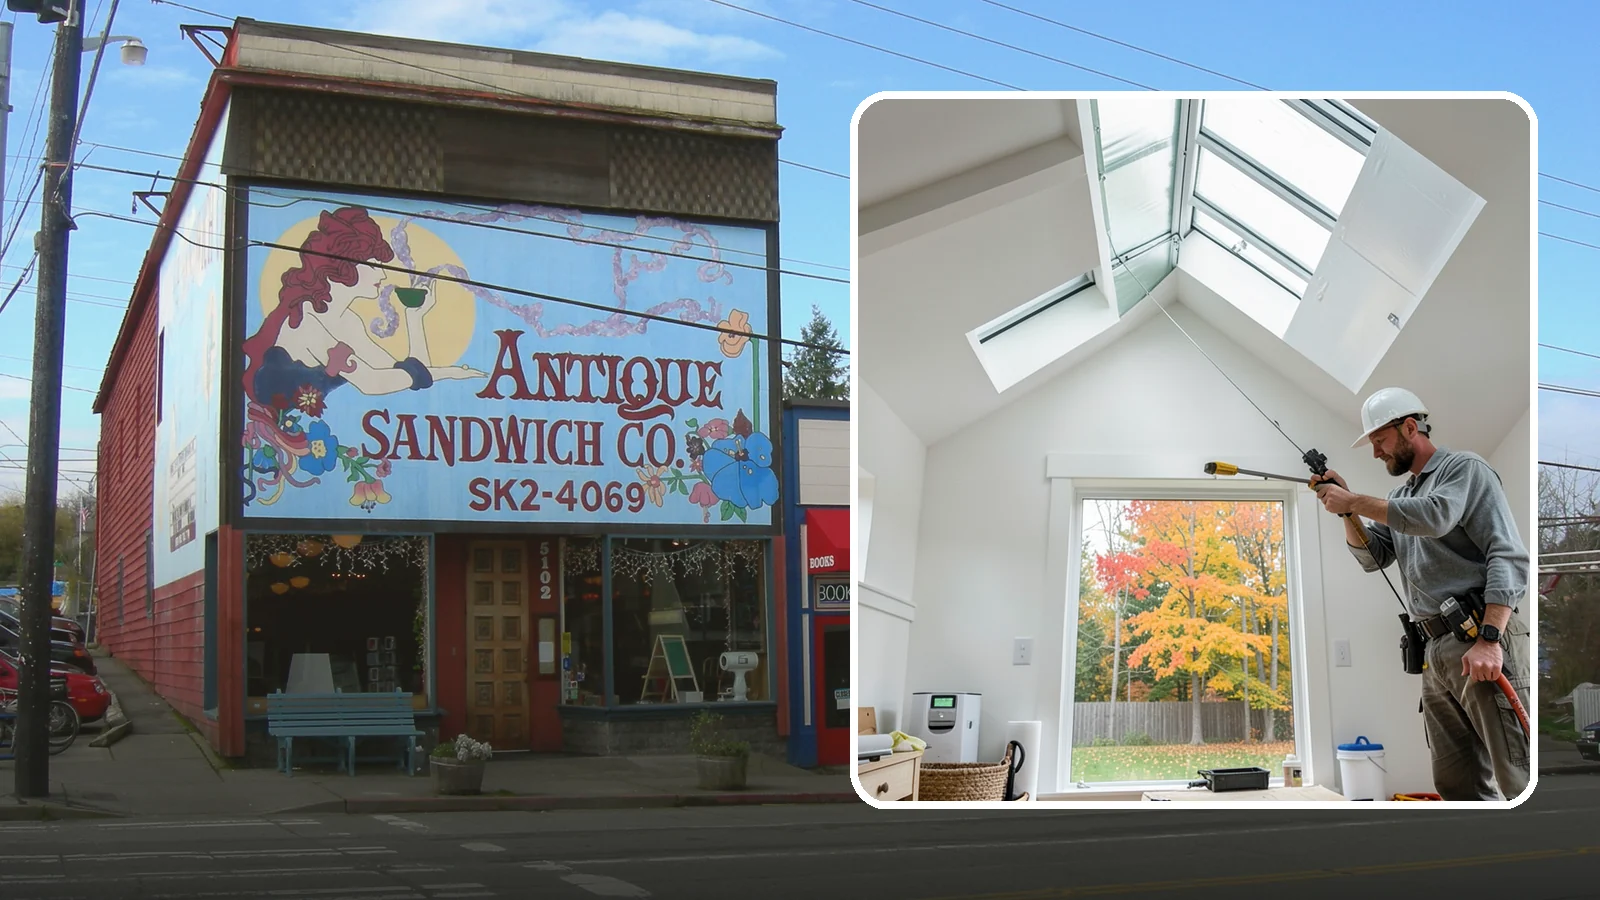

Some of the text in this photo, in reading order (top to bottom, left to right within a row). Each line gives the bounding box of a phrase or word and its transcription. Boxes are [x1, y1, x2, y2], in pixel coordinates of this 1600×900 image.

[476, 329, 723, 420] ANTIQUE
[361, 408, 685, 469] SANDWICH CO.
[469, 477, 646, 512] SK2-4069
[540, 541, 552, 600] 5102
[809, 555, 835, 569] BOOKS
